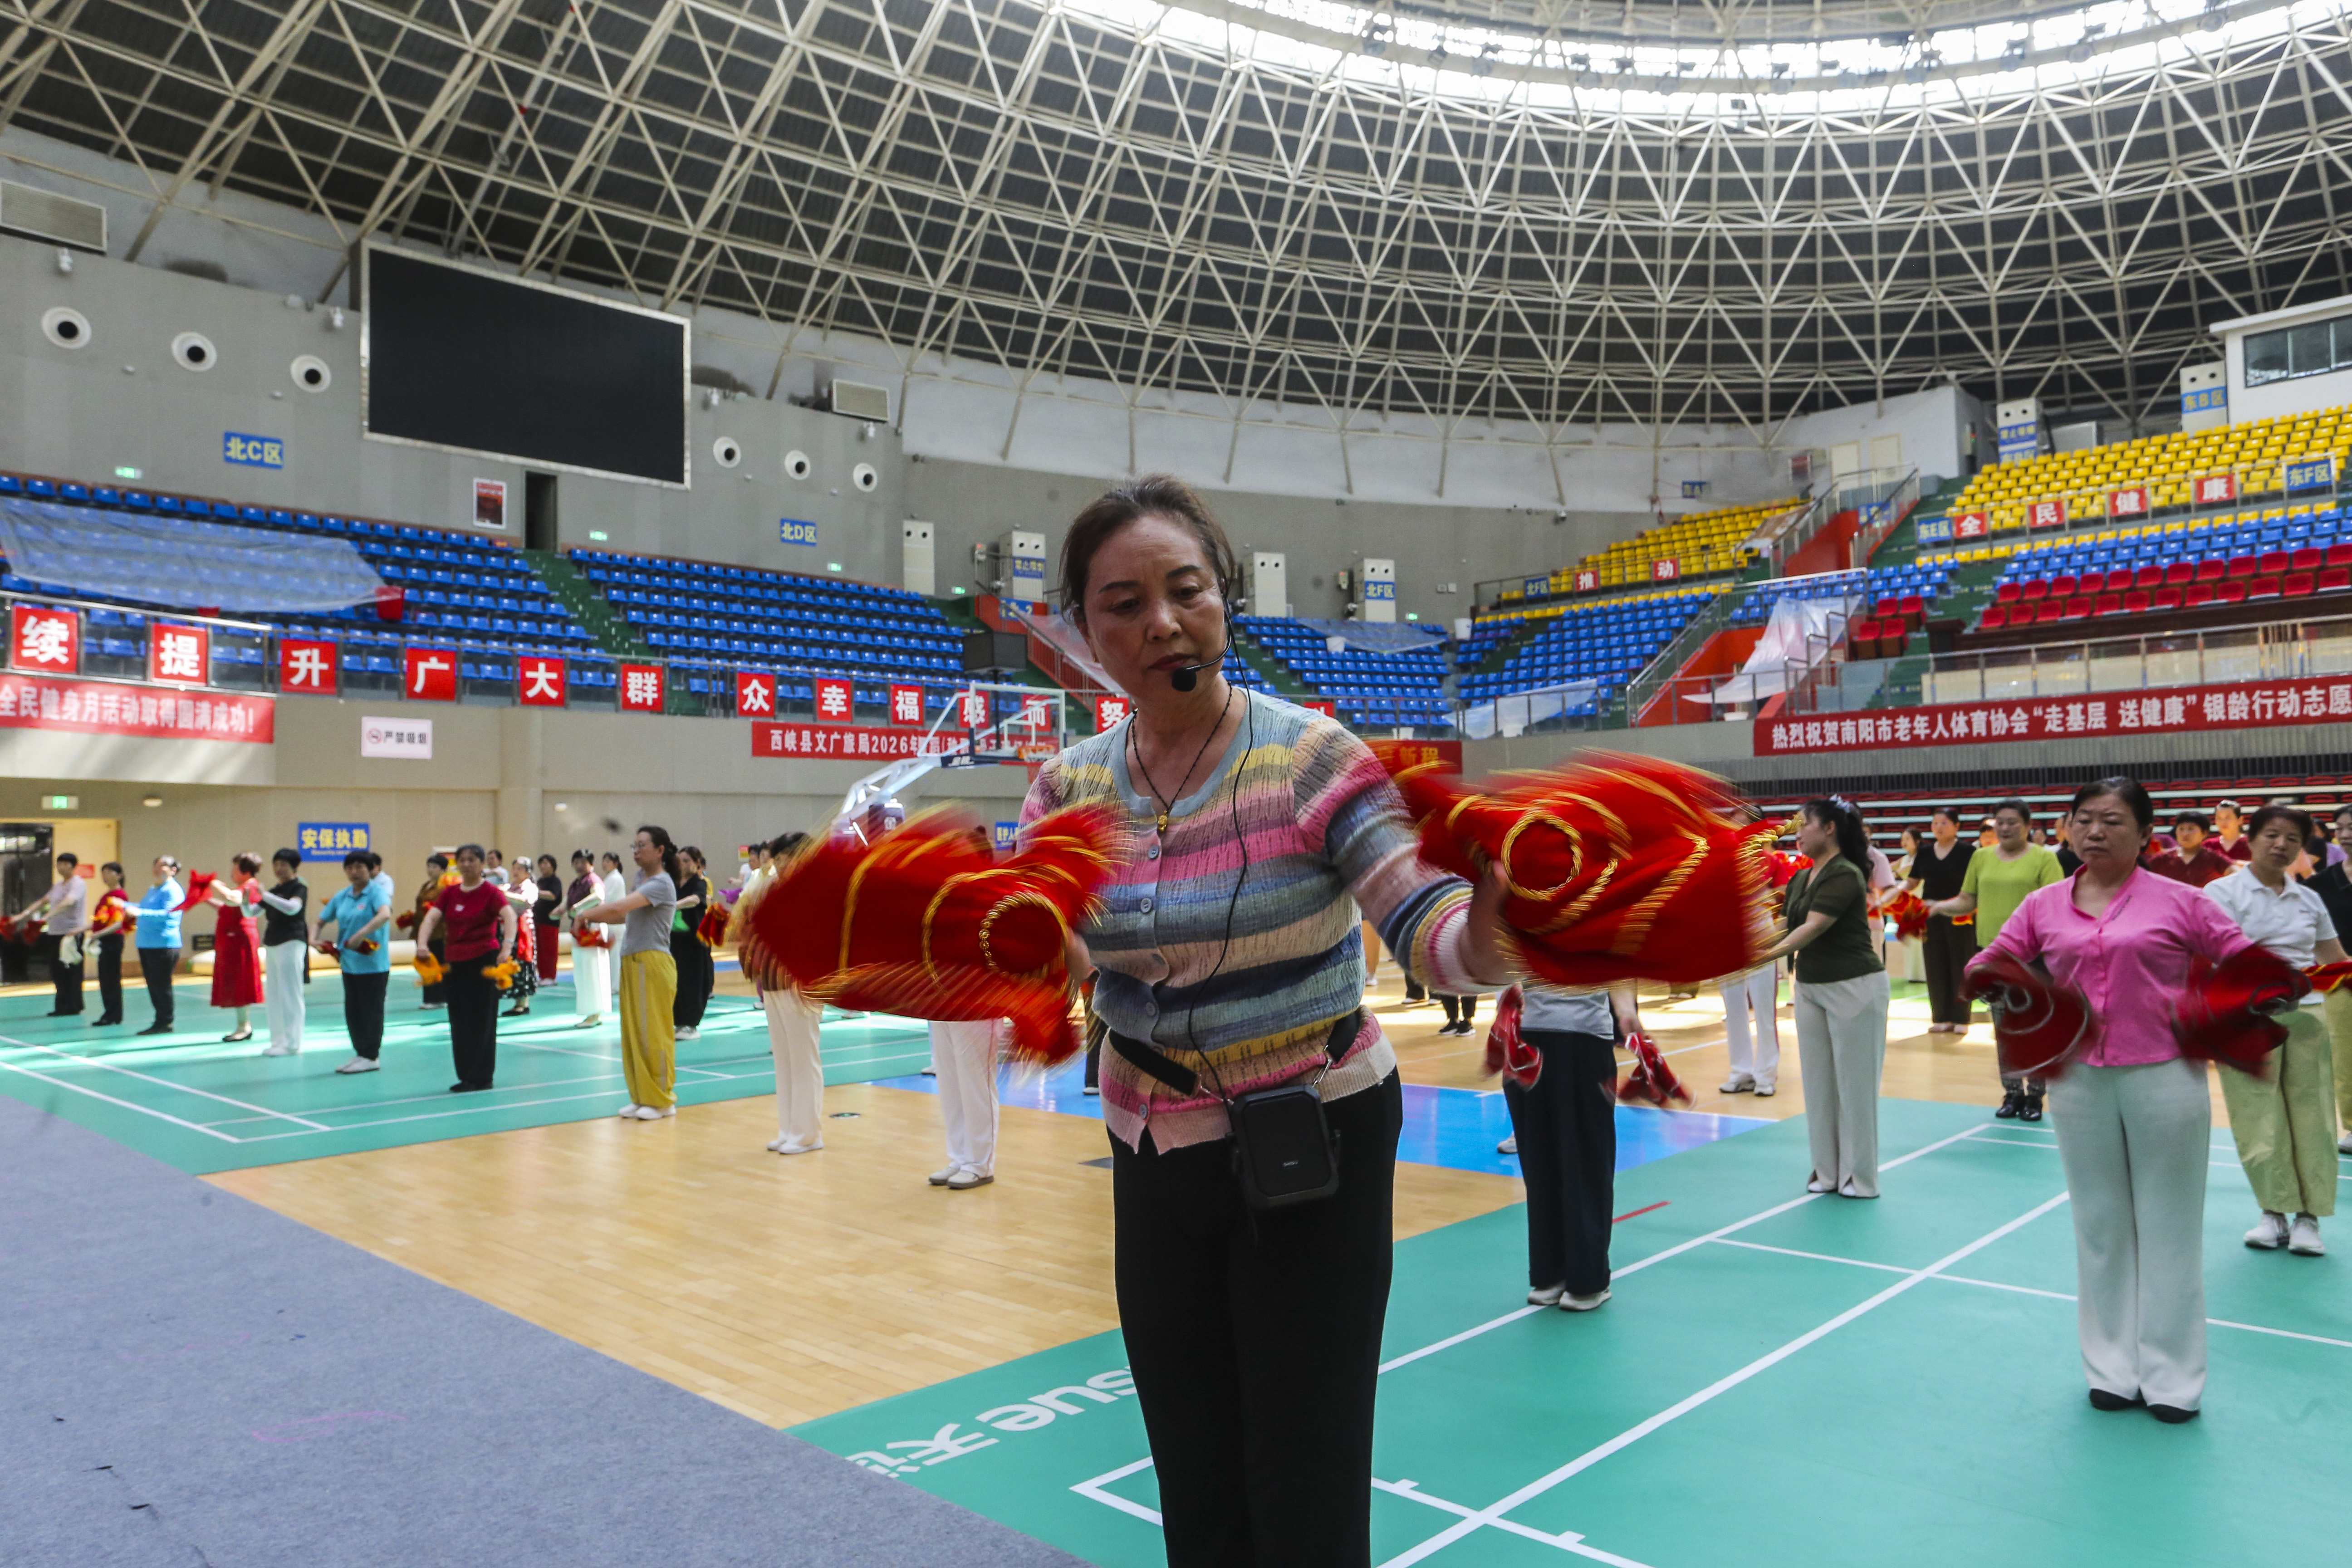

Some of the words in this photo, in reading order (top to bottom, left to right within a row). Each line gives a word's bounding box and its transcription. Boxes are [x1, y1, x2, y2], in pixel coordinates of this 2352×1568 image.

[227, 436, 282, 464] 北C区
[2289, 464, 2329, 489] 东F区
[782, 523, 815, 542] 北D区
[1578, 572, 1594, 590] 推
[1657, 561, 1674, 578] 动
[1960, 515, 1981, 536] 全
[2035, 503, 2058, 524] 民
[2116, 491, 2140, 514] 健
[2203, 479, 2228, 501] 康
[1366, 583, 1394, 598] 北F区
[21, 616, 69, 664] 续
[160, 633, 200, 677] 提
[289, 648, 328, 686] 升
[414, 657, 449, 693] 广
[525, 662, 558, 699] 大
[627, 672, 658, 706] 群
[742, 679, 770, 711] 众
[822, 685, 847, 715] 幸
[896, 691, 919, 721] 福
[1100, 700, 1124, 728] 努
[385, 731, 426, 744] 严禁吸烟
[302, 828, 368, 849] 安保执勤
